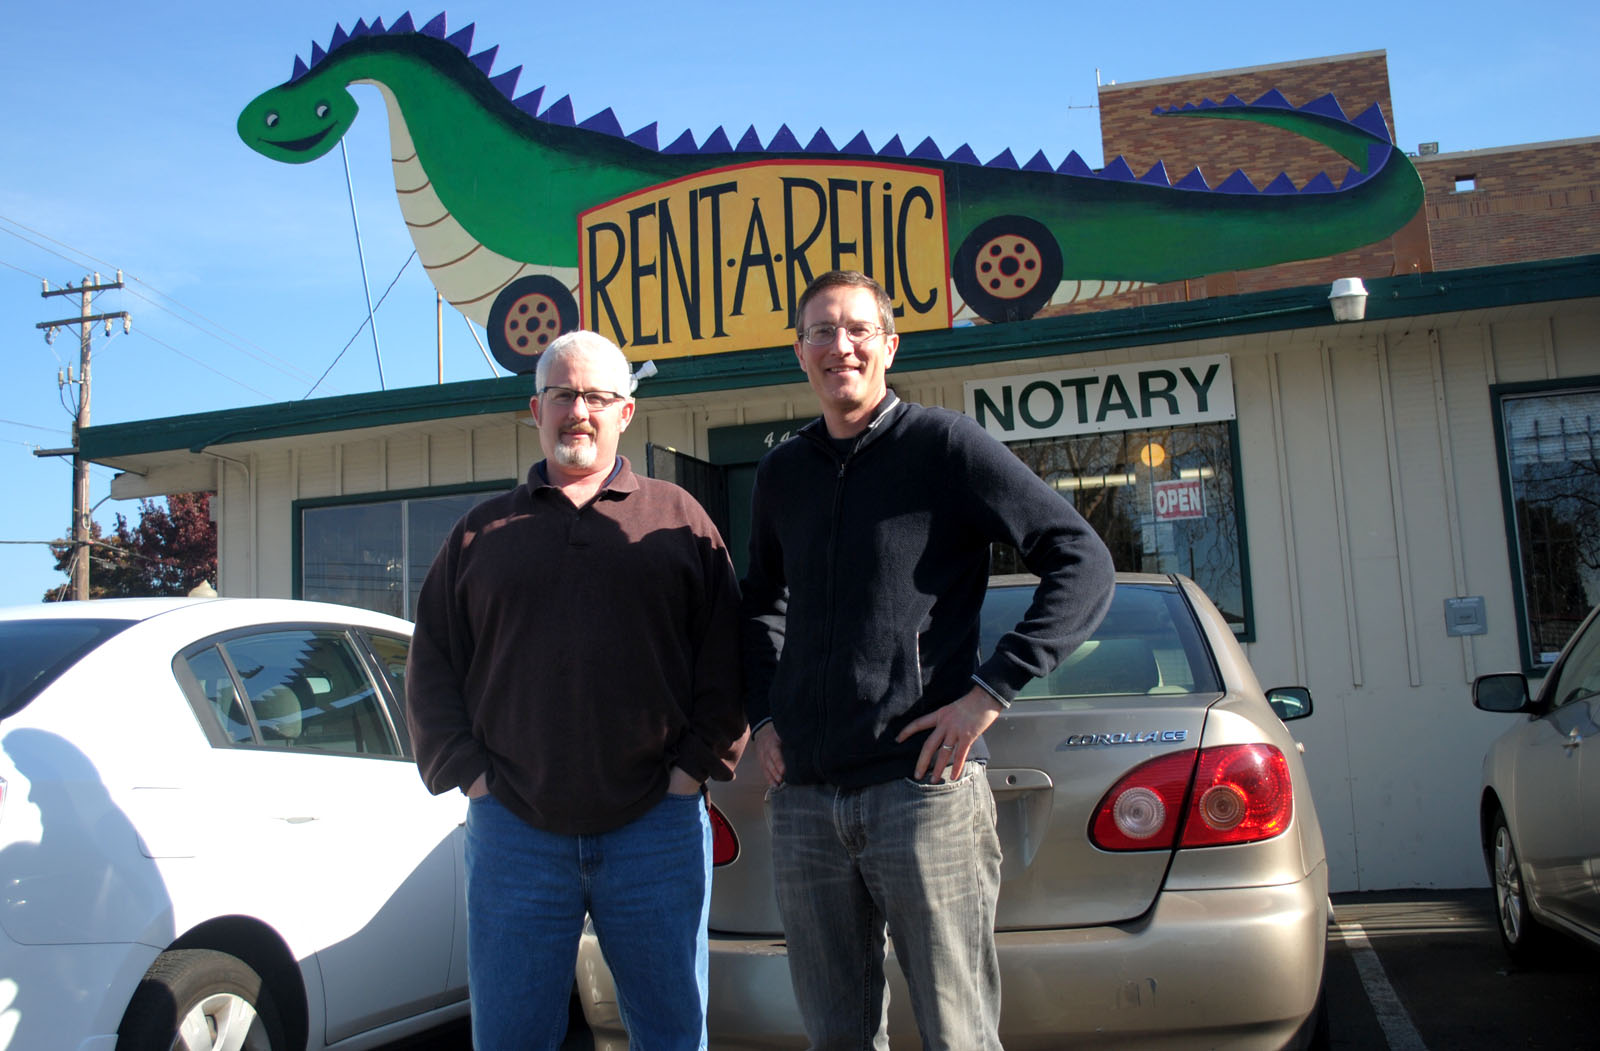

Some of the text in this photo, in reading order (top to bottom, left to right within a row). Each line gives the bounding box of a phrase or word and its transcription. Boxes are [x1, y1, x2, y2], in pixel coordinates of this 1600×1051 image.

[974, 364, 1220, 431] NOTARY
[1156, 487, 1201, 514] OPEN
[1066, 730, 1188, 745] COROLLA CE
